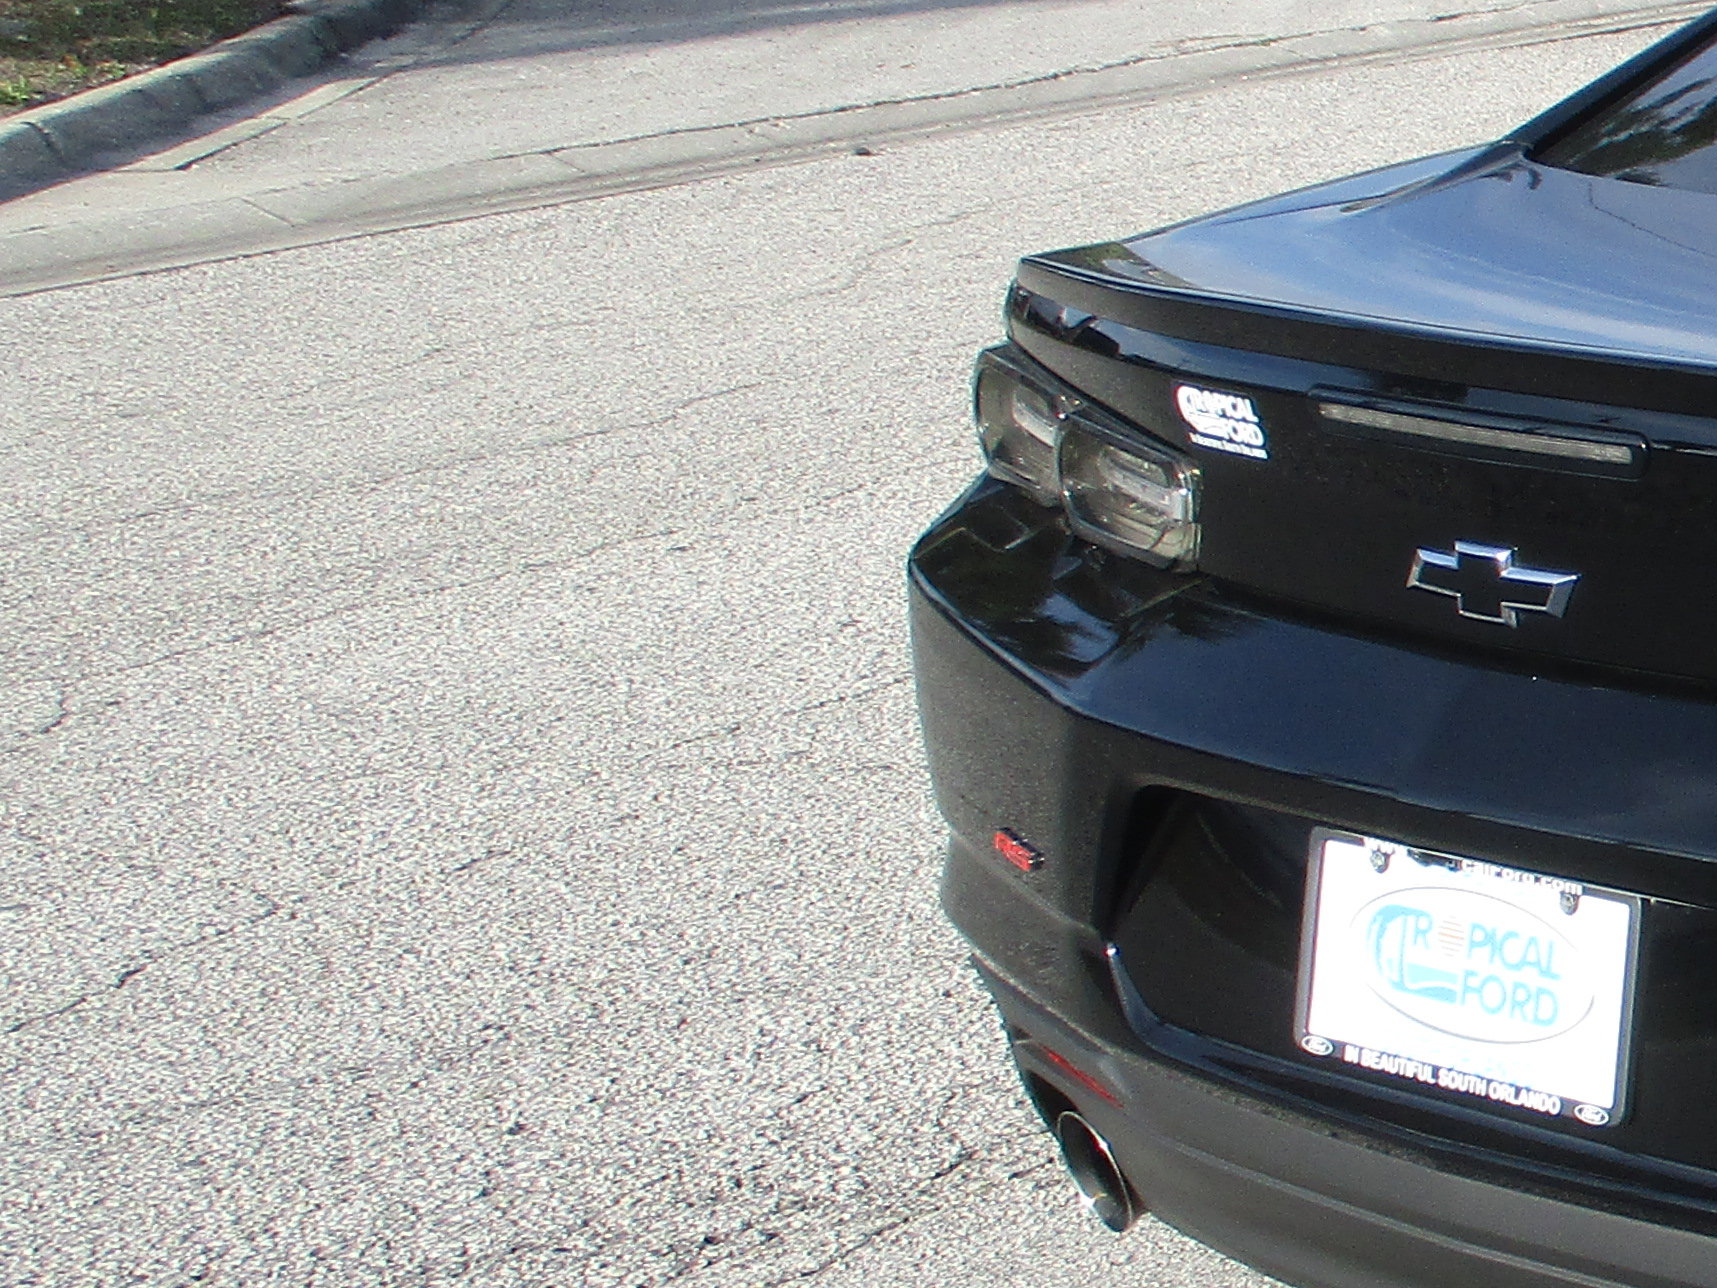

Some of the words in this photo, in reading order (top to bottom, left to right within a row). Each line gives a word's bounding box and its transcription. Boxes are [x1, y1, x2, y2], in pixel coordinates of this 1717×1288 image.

[1367, 904, 1562, 982] TROPICAL
[1460, 968, 1559, 1028] FORD
[1344, 1044, 1360, 1064] IN
[1361, 1048, 1437, 1084] BEAUTIFUL
[1438, 1066, 1487, 1097] SOUTH
[1488, 1082, 1562, 1116] ORLANDO
